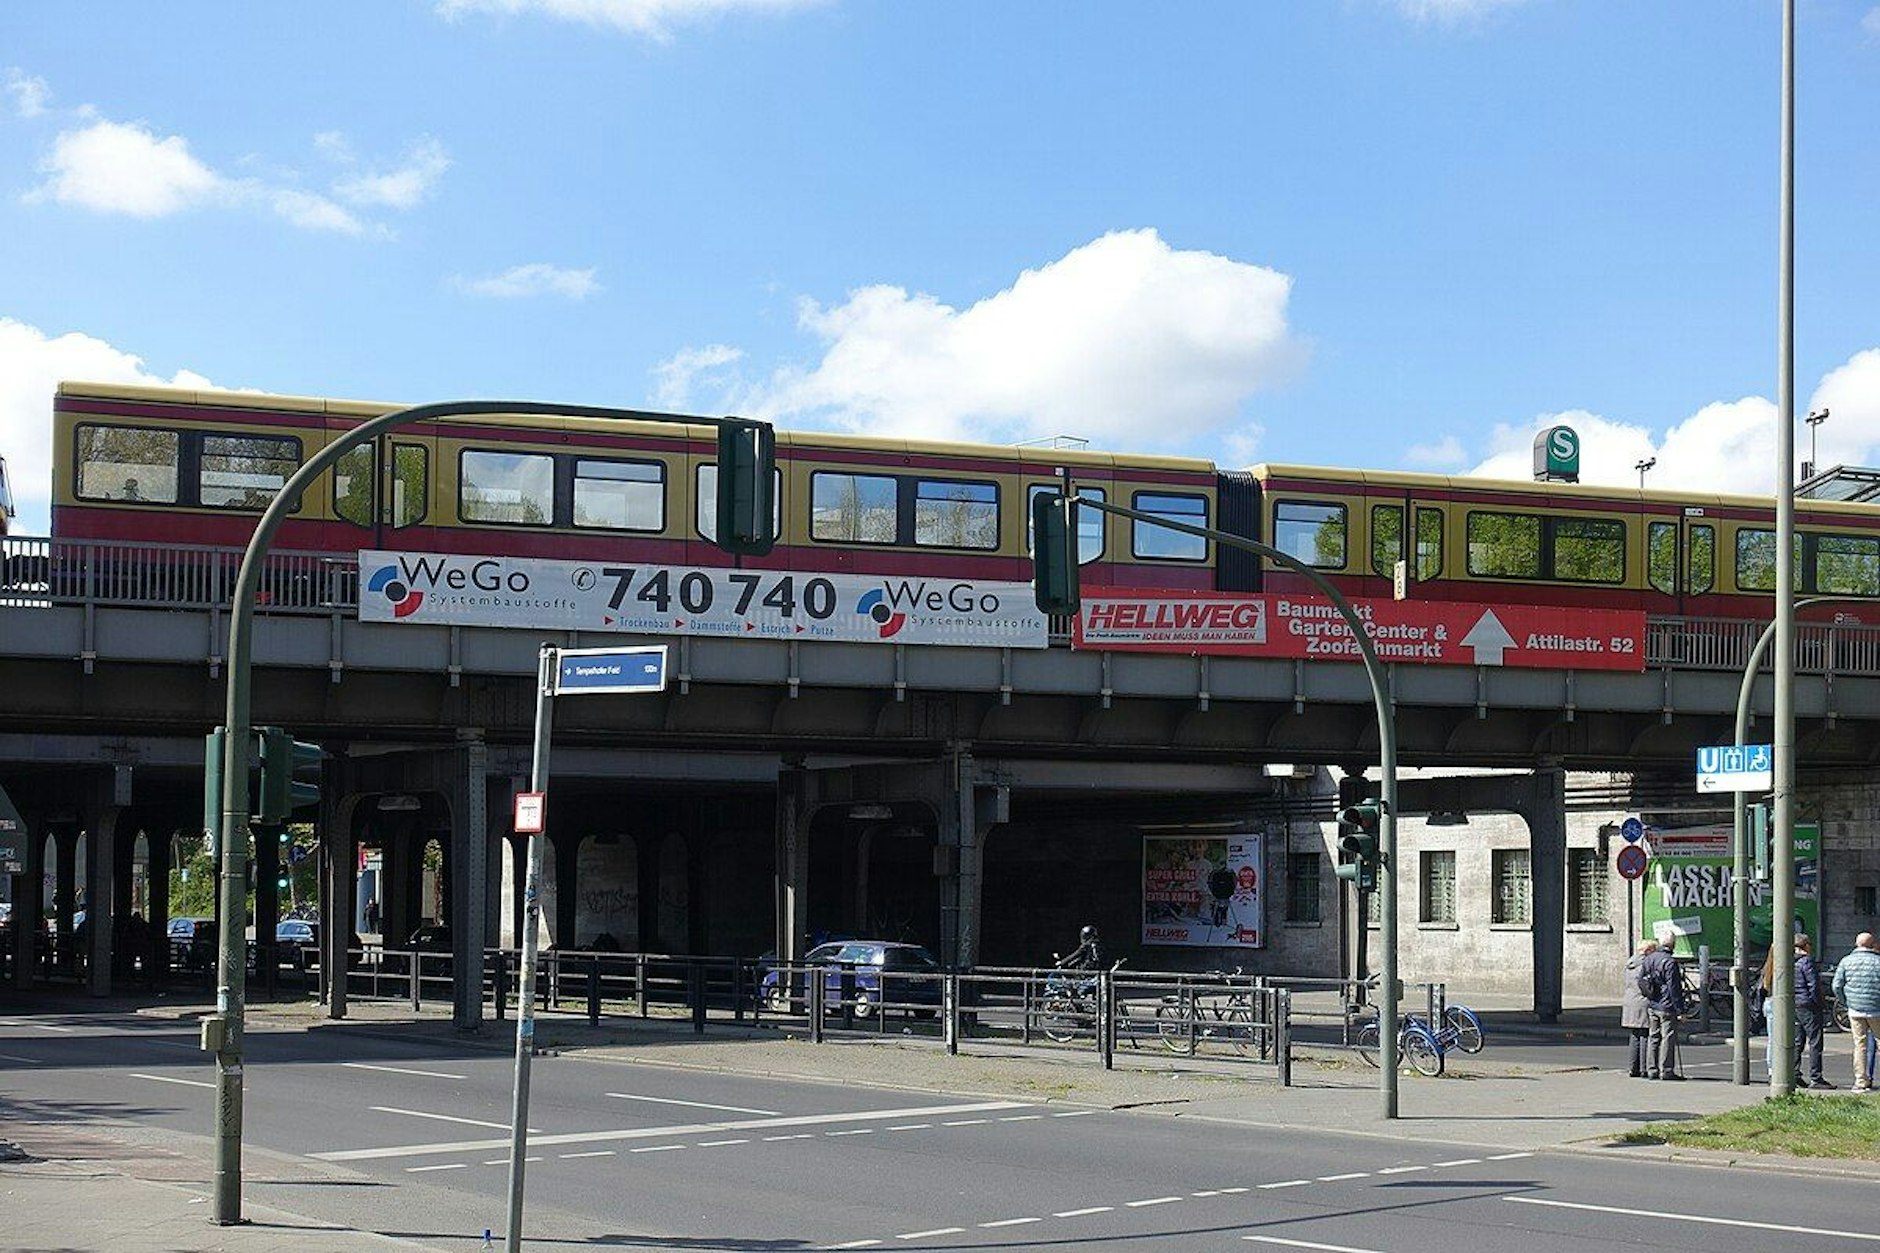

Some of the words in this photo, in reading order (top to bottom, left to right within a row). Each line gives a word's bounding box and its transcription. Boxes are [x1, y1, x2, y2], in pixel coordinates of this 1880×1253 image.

[1553, 430, 1574, 458] S
[399, 555, 530, 592] WeGo
[430, 593, 577, 611] Systembaustoffe
[602, 568, 713, 615] 740
[728, 574, 837, 620] 740
[885, 579, 1000, 614] WeGo
[911, 613, 1041, 630] Systembaustoffe
[1087, 602, 1260, 630] HELLWEG
[1277, 601, 1372, 621] Baumakt
[619, 616, 670, 629] Trockenbau
[761, 622, 791, 635] Estrich
[810, 625, 834, 636] Putze
[1142, 632, 1171, 641] IDEEN
[1173, 633, 1200, 641] MUSS
[1202, 633, 1222, 641] MAN
[1224, 633, 1256, 641] HABEN
[1434, 623, 1448, 641] &
[1306, 636, 1442, 658] Zoofahmarkt
[1525, 633, 1604, 653] Attilastr.
[1611, 636, 1634, 653] 52
[1700, 747, 1719, 773] U
[1655, 863, 1714, 888] LASS
[1662, 884, 1762, 908] MACHN
